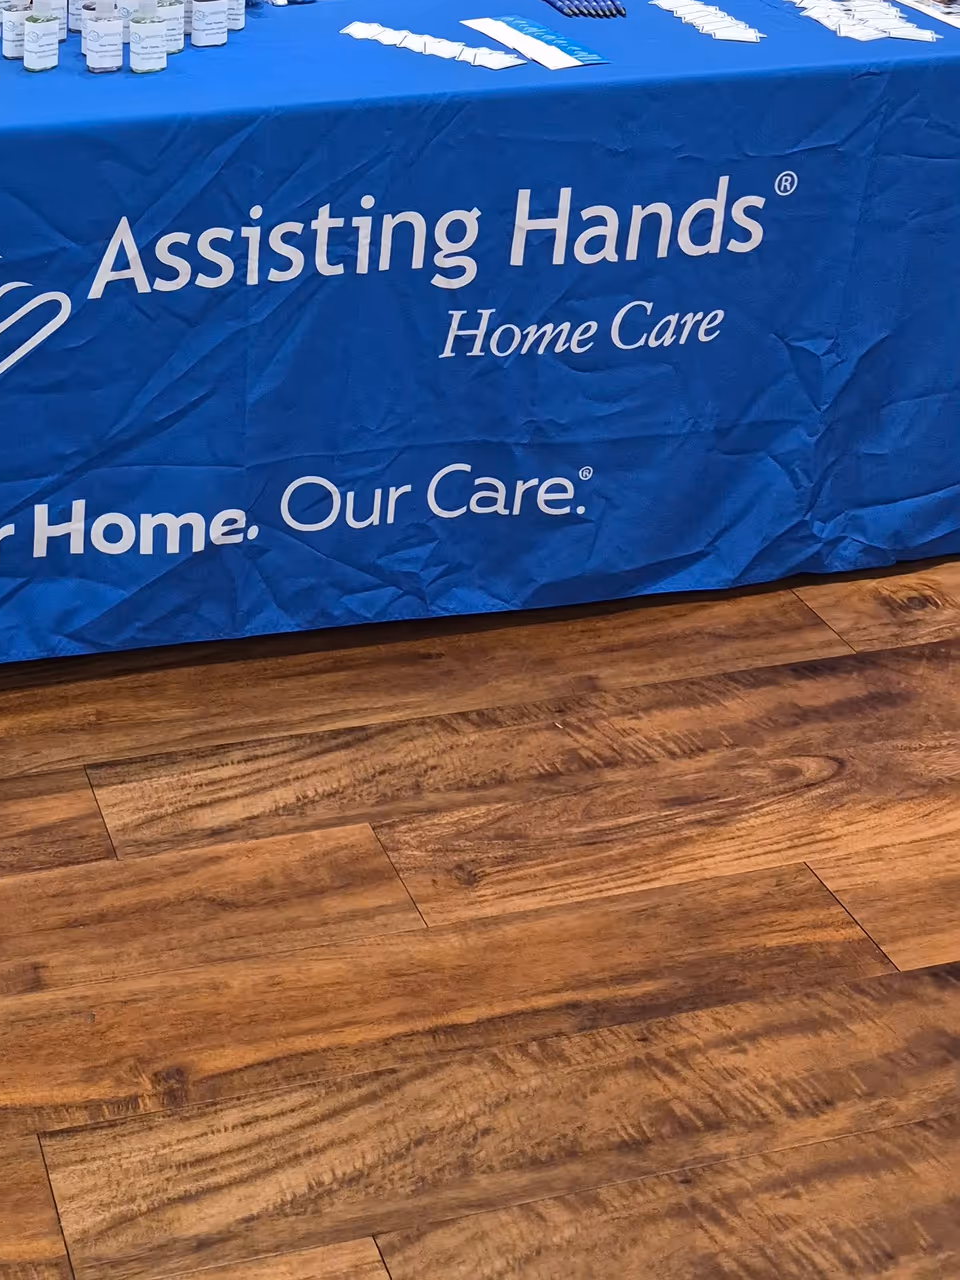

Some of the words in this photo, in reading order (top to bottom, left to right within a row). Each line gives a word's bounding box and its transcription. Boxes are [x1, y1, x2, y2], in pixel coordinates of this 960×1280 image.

[88, 193, 482, 300] Assisting
[439, 306, 599, 360] Home
[610, 301, 726, 352] Care
[32, 498, 261, 559] Home.
[280, 475, 412, 533] Our
